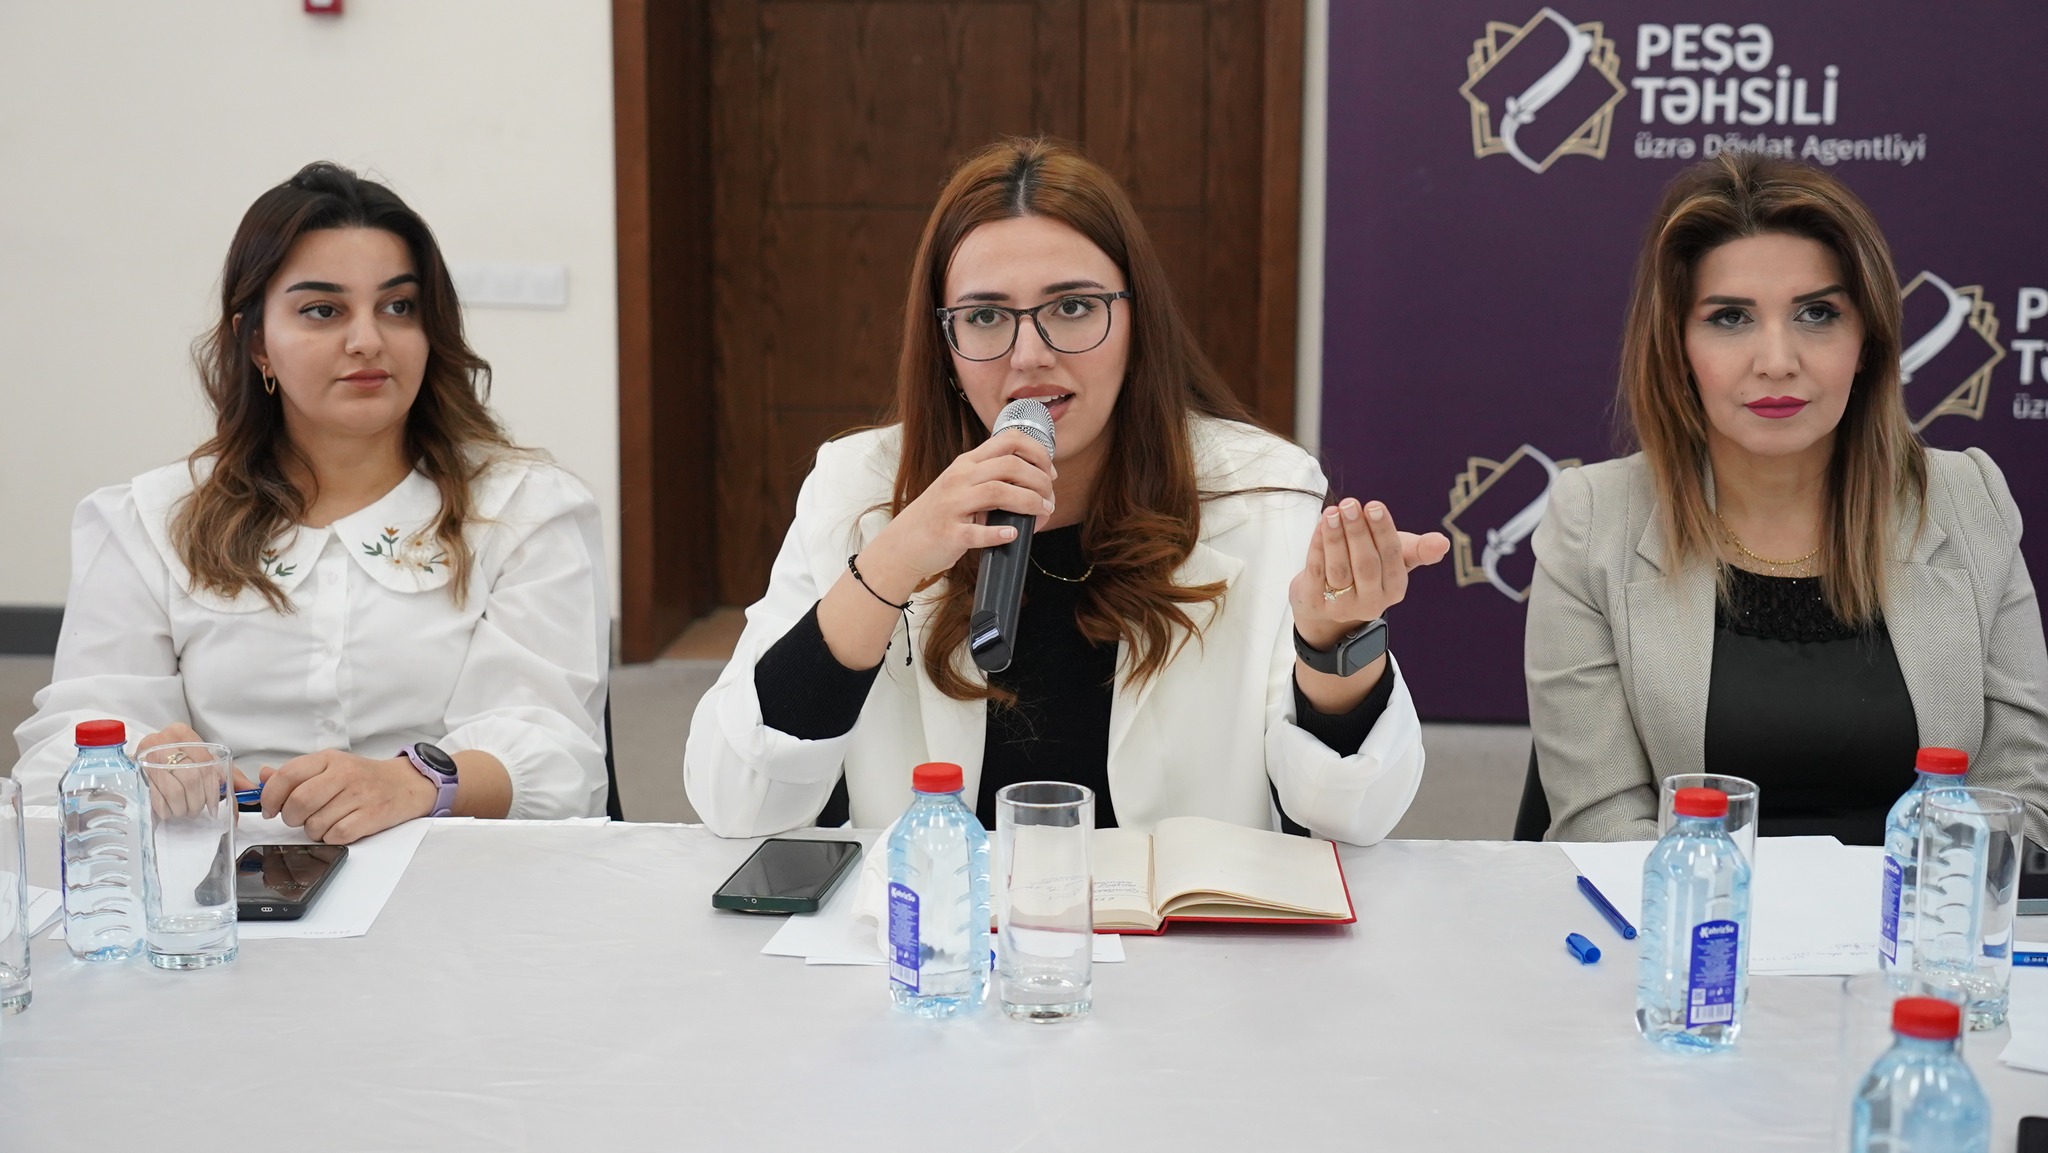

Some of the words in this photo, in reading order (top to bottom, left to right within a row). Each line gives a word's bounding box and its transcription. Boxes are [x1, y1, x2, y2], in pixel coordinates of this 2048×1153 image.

[1636, 23, 1774, 76] PEŞƏ
[1631, 64, 1840, 125] TƏHSİLİ
[1634, 131, 1697, 159] üzrə
[1802, 133, 1928, 166] Agentliyi
